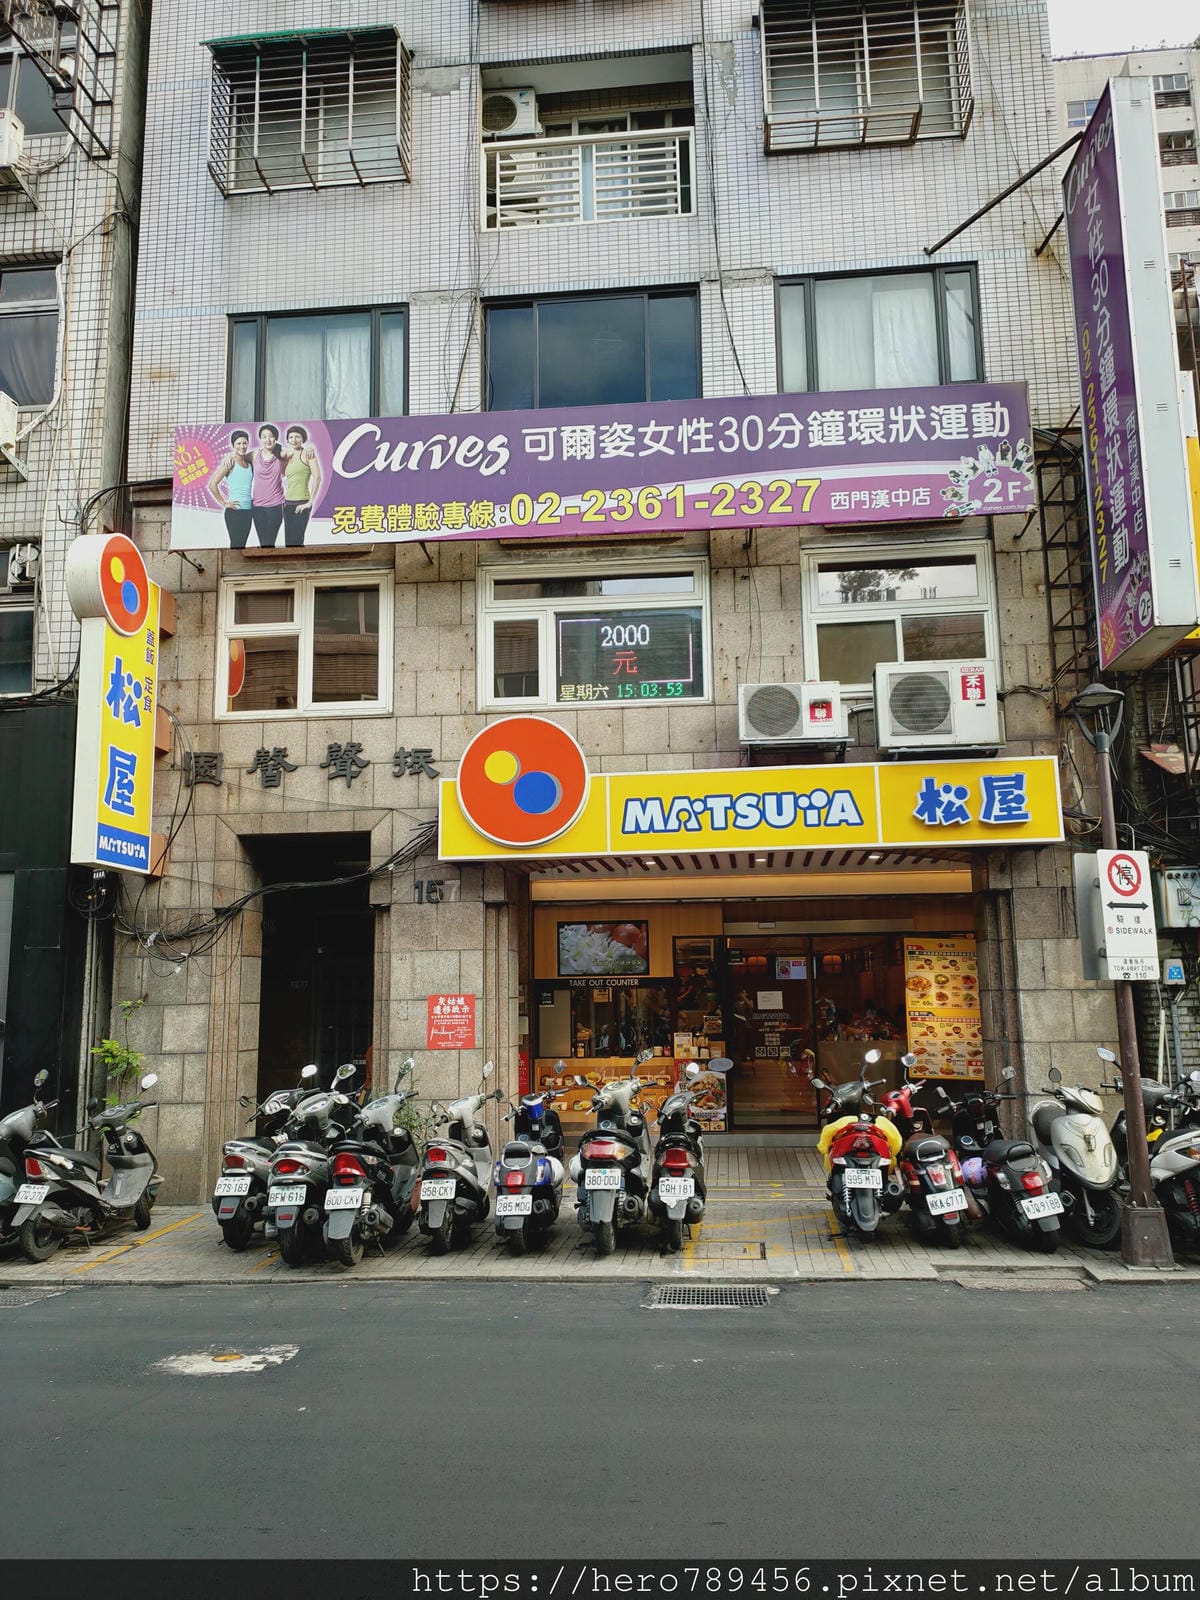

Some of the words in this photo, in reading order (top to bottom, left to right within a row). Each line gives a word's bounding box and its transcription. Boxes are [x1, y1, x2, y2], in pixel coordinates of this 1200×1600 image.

[1066, 108, 1112, 215] Curves
[522, 400, 1010, 462] 可爾姿女性30分鐘環狀運動
[332, 422, 511, 479] Curves
[830, 487, 931, 511] 西門漢中店
[983, 478, 1021, 503] 2F
[601, 624, 650, 646] 2000
[612, 650, 638, 675] 元
[560, 684, 609, 701] 星期六
[105, 656, 143, 817] 松屋
[622, 788, 864, 835] MATSUYA
[912, 773, 1031, 827] 松屋
[99, 834, 147, 861] MATSUYA
[1116, 927, 1153, 935] SIDEWALK
[569, 979, 587, 987] TAKE
